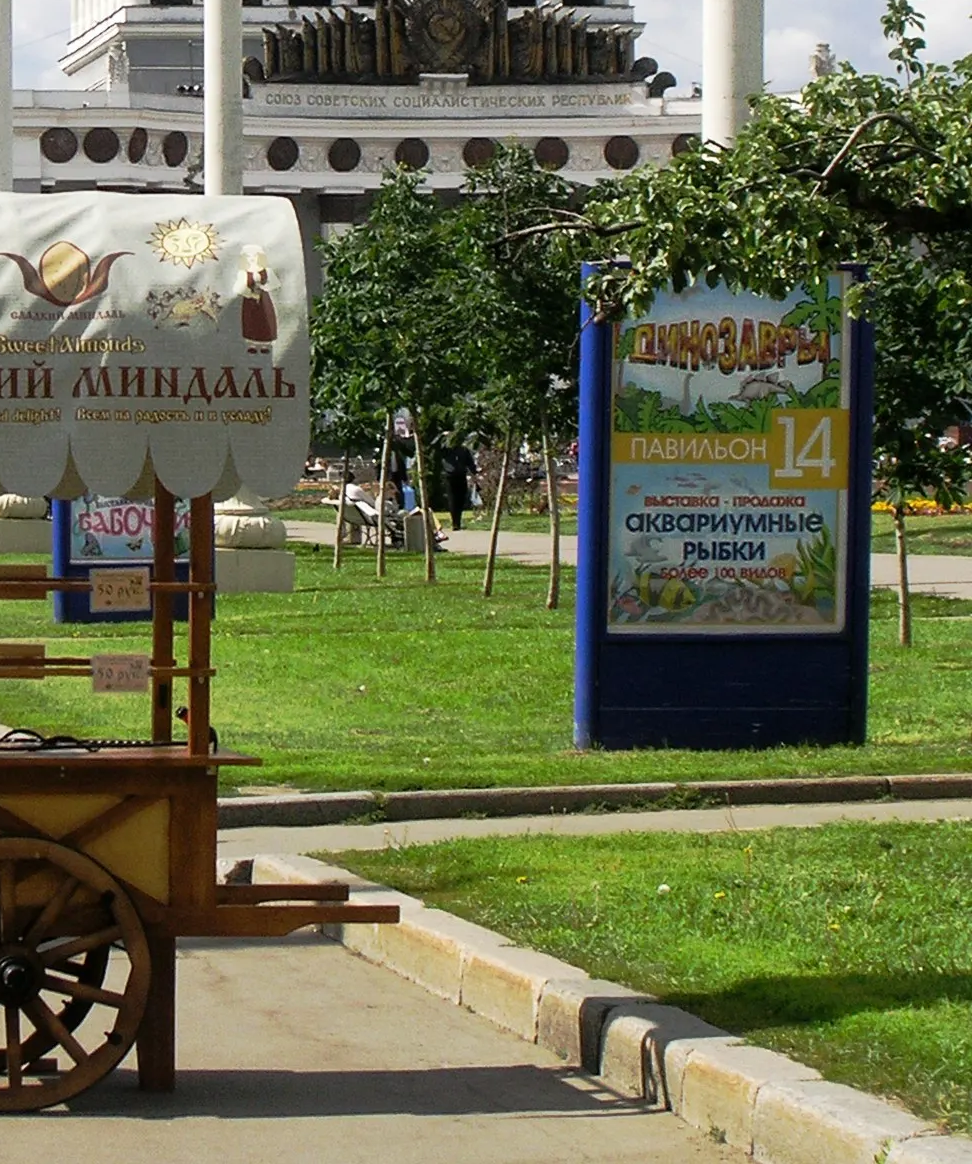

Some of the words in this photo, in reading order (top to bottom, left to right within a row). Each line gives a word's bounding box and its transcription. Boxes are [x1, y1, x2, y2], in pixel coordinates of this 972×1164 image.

[265, 93, 301, 106] СОЮЗ
[307, 93, 387, 108] СОВЕТСКИХ
[393, 94, 545, 109] СОЦИАЛИСТИЧЕСКИХ
[551, 93, 632, 107] РЕСПУБЛИК
[59, 334, 146, 355] Almonds
[629, 316, 832, 375] ДИНОЗАВРЫ
[71, 366, 296, 405] МИНДАЛЬ
[114, 409, 131, 422] на
[630, 437, 767, 460] ПАВИЛЬОН
[774, 416, 837, 478] 14
[78, 506, 191, 536] БАБОЧИ
[683, 541, 766, 562] РЫБКИ
[714, 567, 736, 579] 100
